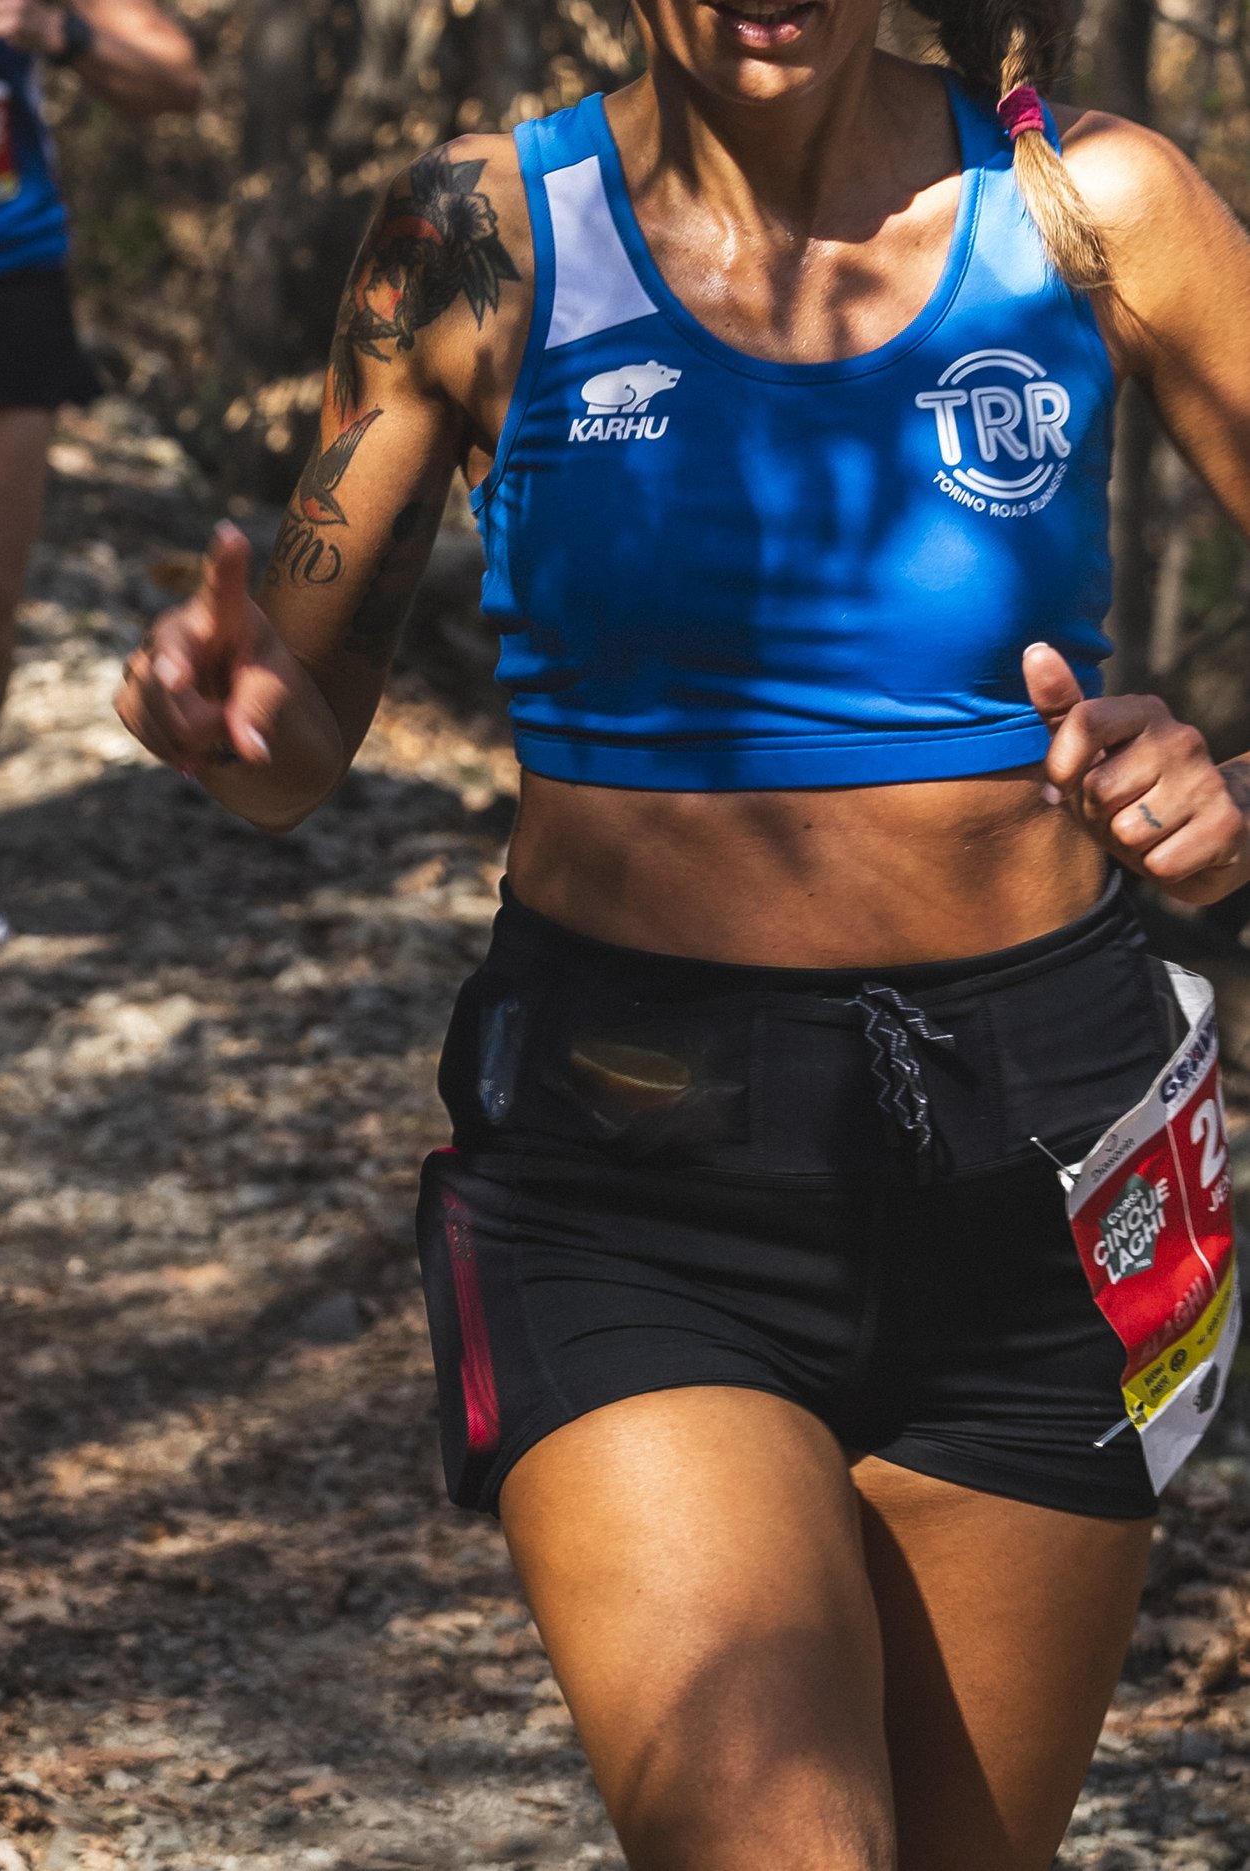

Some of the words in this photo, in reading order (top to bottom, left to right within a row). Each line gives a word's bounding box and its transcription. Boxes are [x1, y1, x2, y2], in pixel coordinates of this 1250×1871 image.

[568, 416, 670, 442] KARHU
[915, 381, 1071, 466] TRR
[932, 469, 987, 512] TORINO
[989, 502, 1028, 519] ROAD
[1093, 1177, 1171, 1266] CINQUE
[1106, 1207, 1167, 1286] LAGHI
